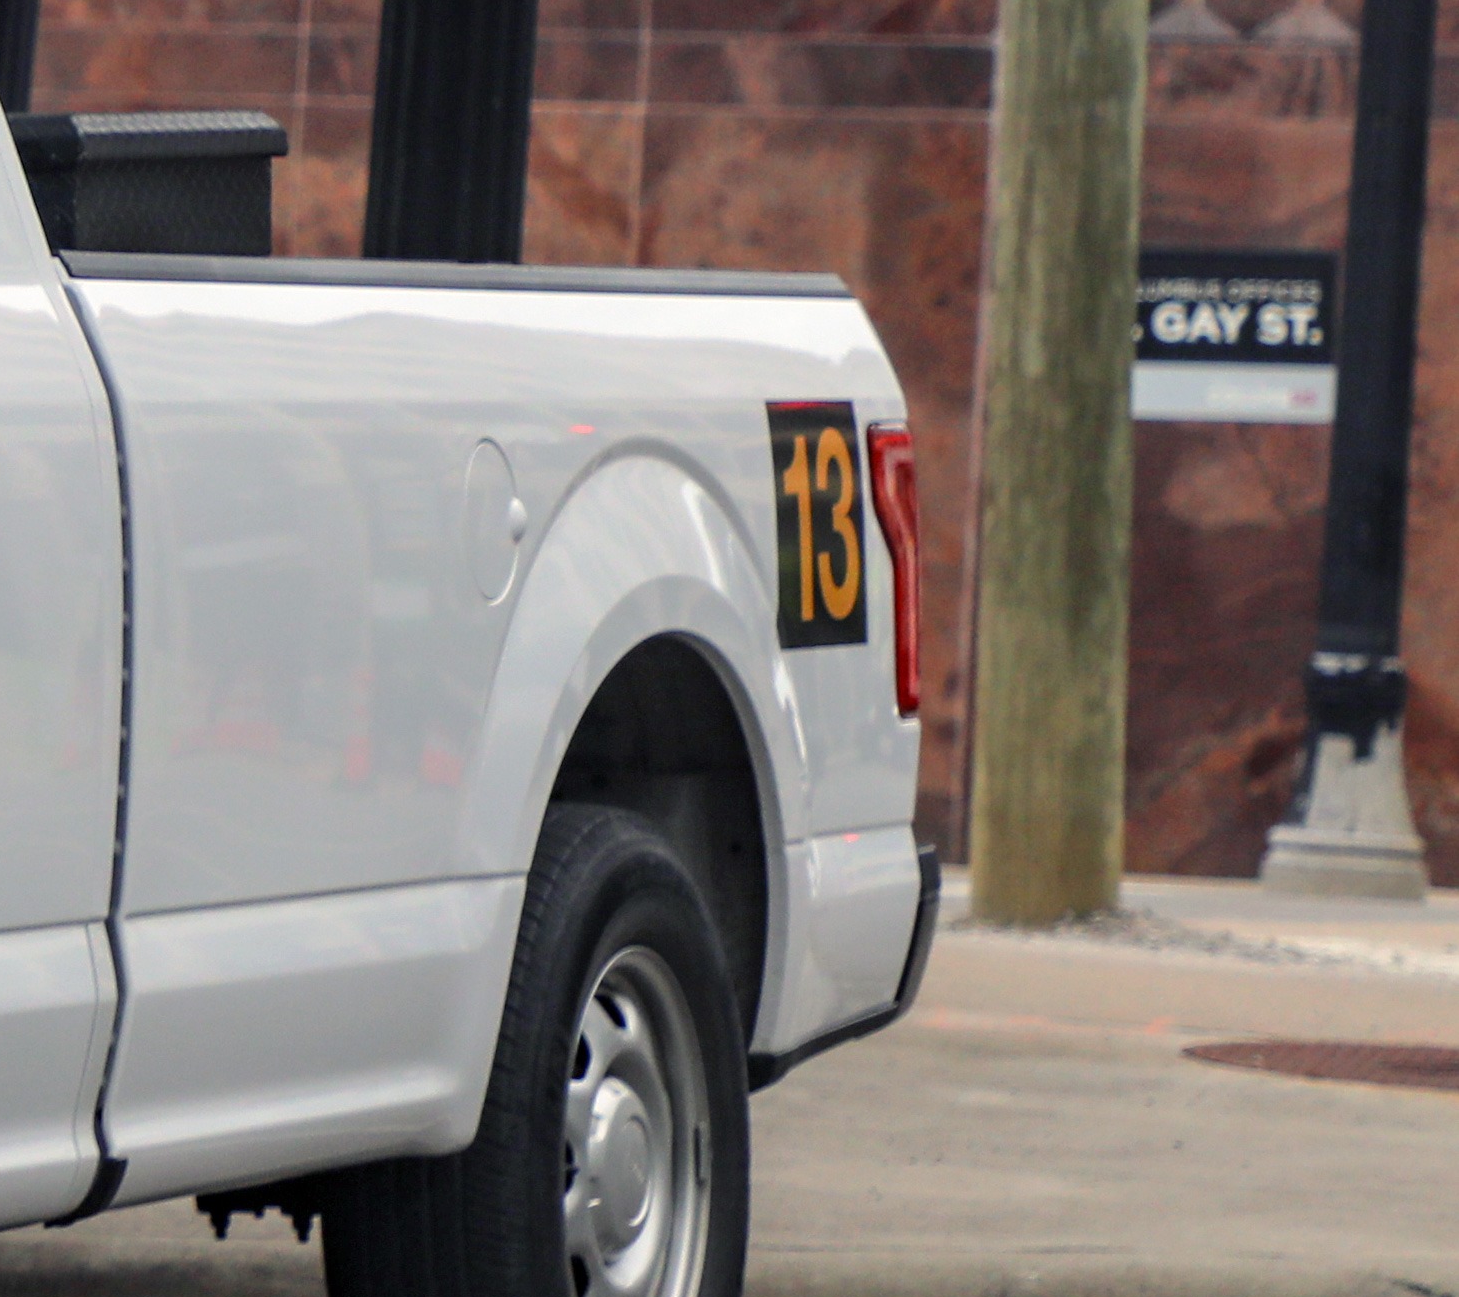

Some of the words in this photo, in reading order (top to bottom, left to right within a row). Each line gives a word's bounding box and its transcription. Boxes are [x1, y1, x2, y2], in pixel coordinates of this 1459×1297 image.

[1151, 301, 1250, 344] GAY
[1257, 303, 1322, 345] ST.
[782, 426, 861, 622] 13
